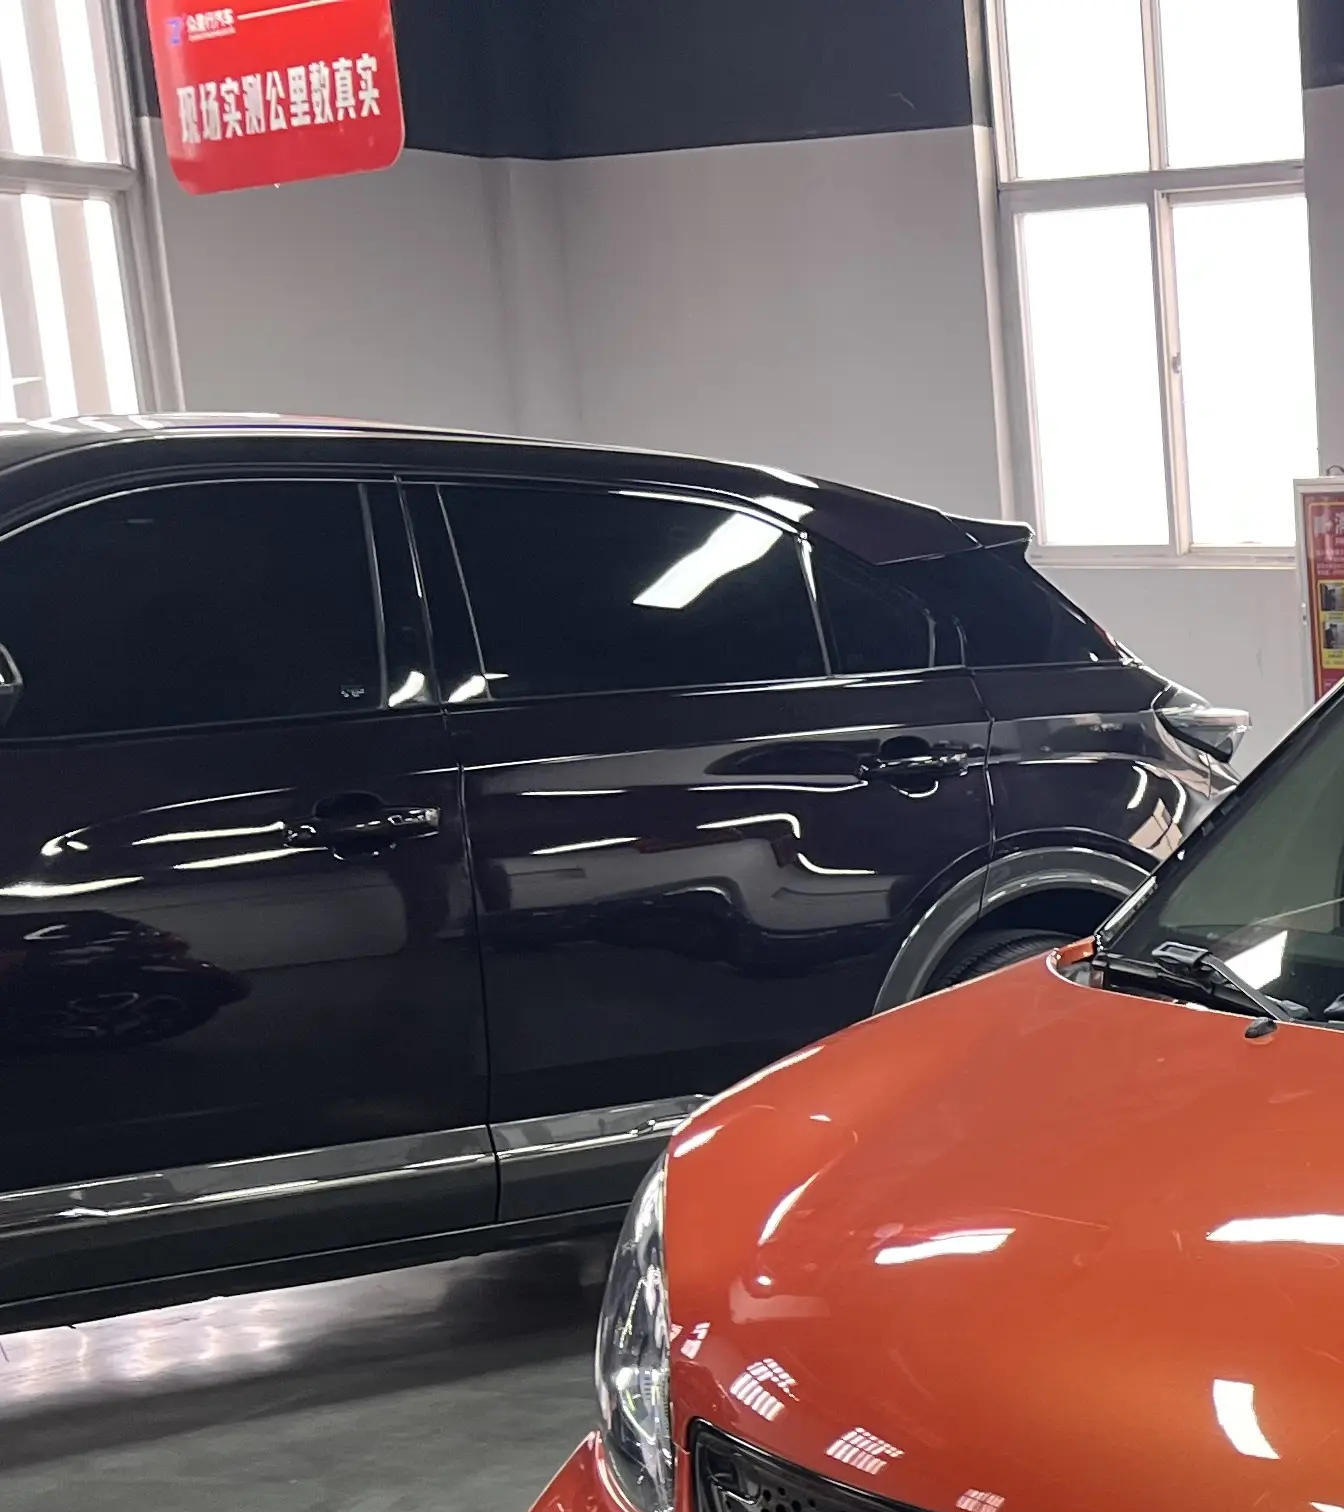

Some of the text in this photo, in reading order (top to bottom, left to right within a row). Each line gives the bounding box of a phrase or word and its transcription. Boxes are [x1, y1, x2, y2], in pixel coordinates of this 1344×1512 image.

[176, 52, 382, 145] 现场实测公里数真实
